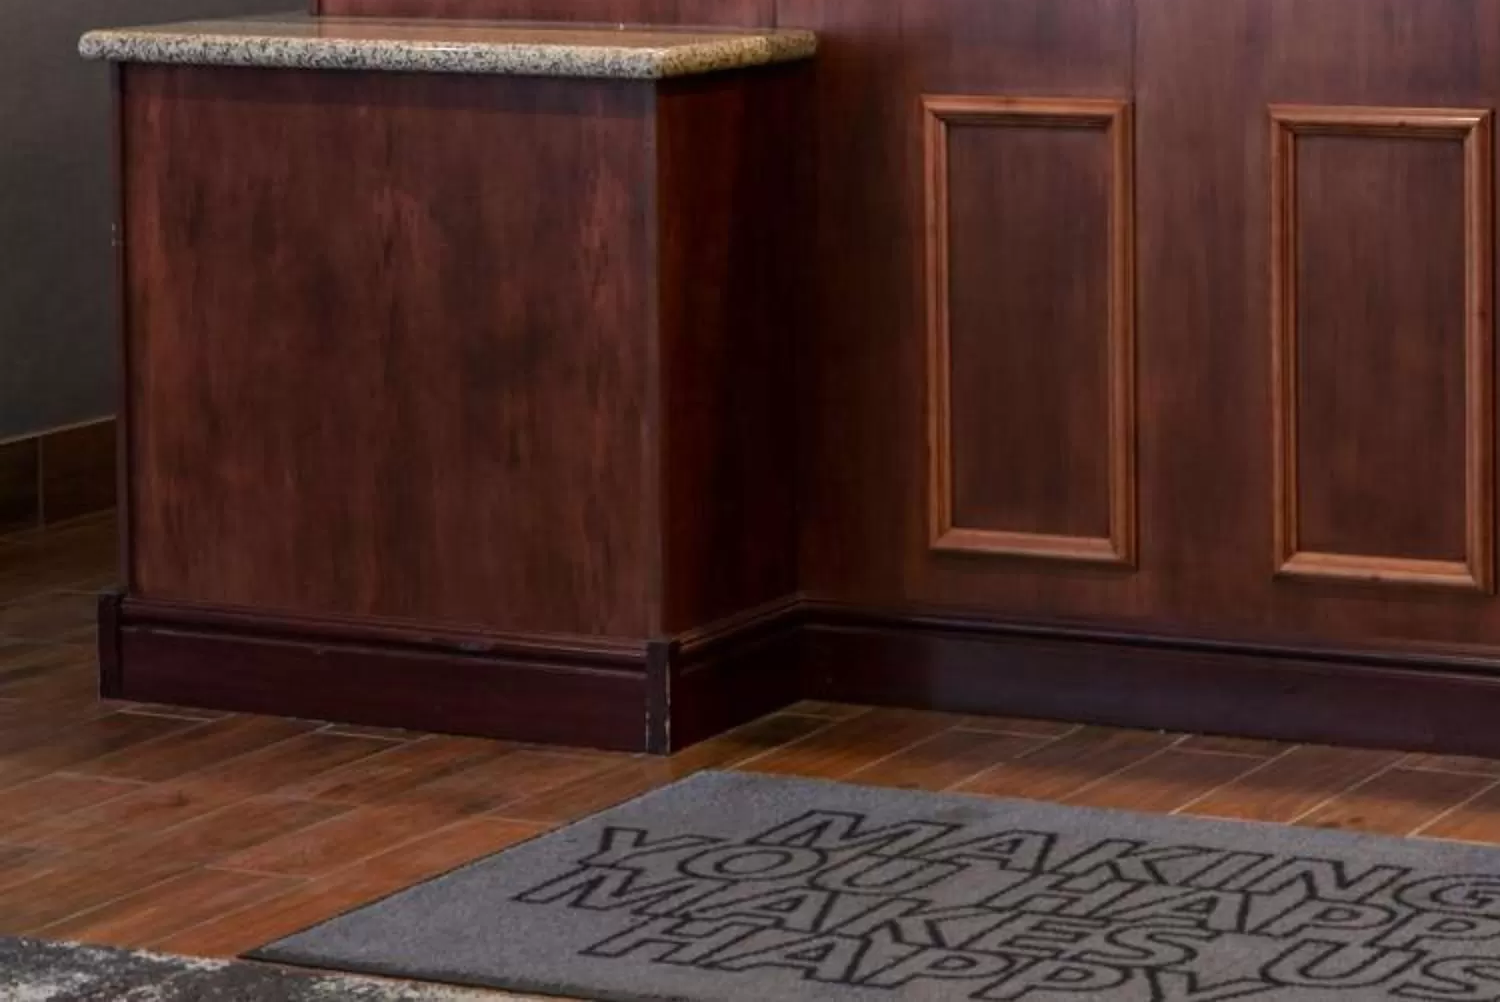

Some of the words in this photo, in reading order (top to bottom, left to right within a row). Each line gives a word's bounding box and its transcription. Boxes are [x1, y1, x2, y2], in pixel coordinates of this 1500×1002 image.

[577, 827, 968, 895] YOU
[511, 865, 1223, 967] MAKES
[578, 916, 1292, 1002] HAPPY
